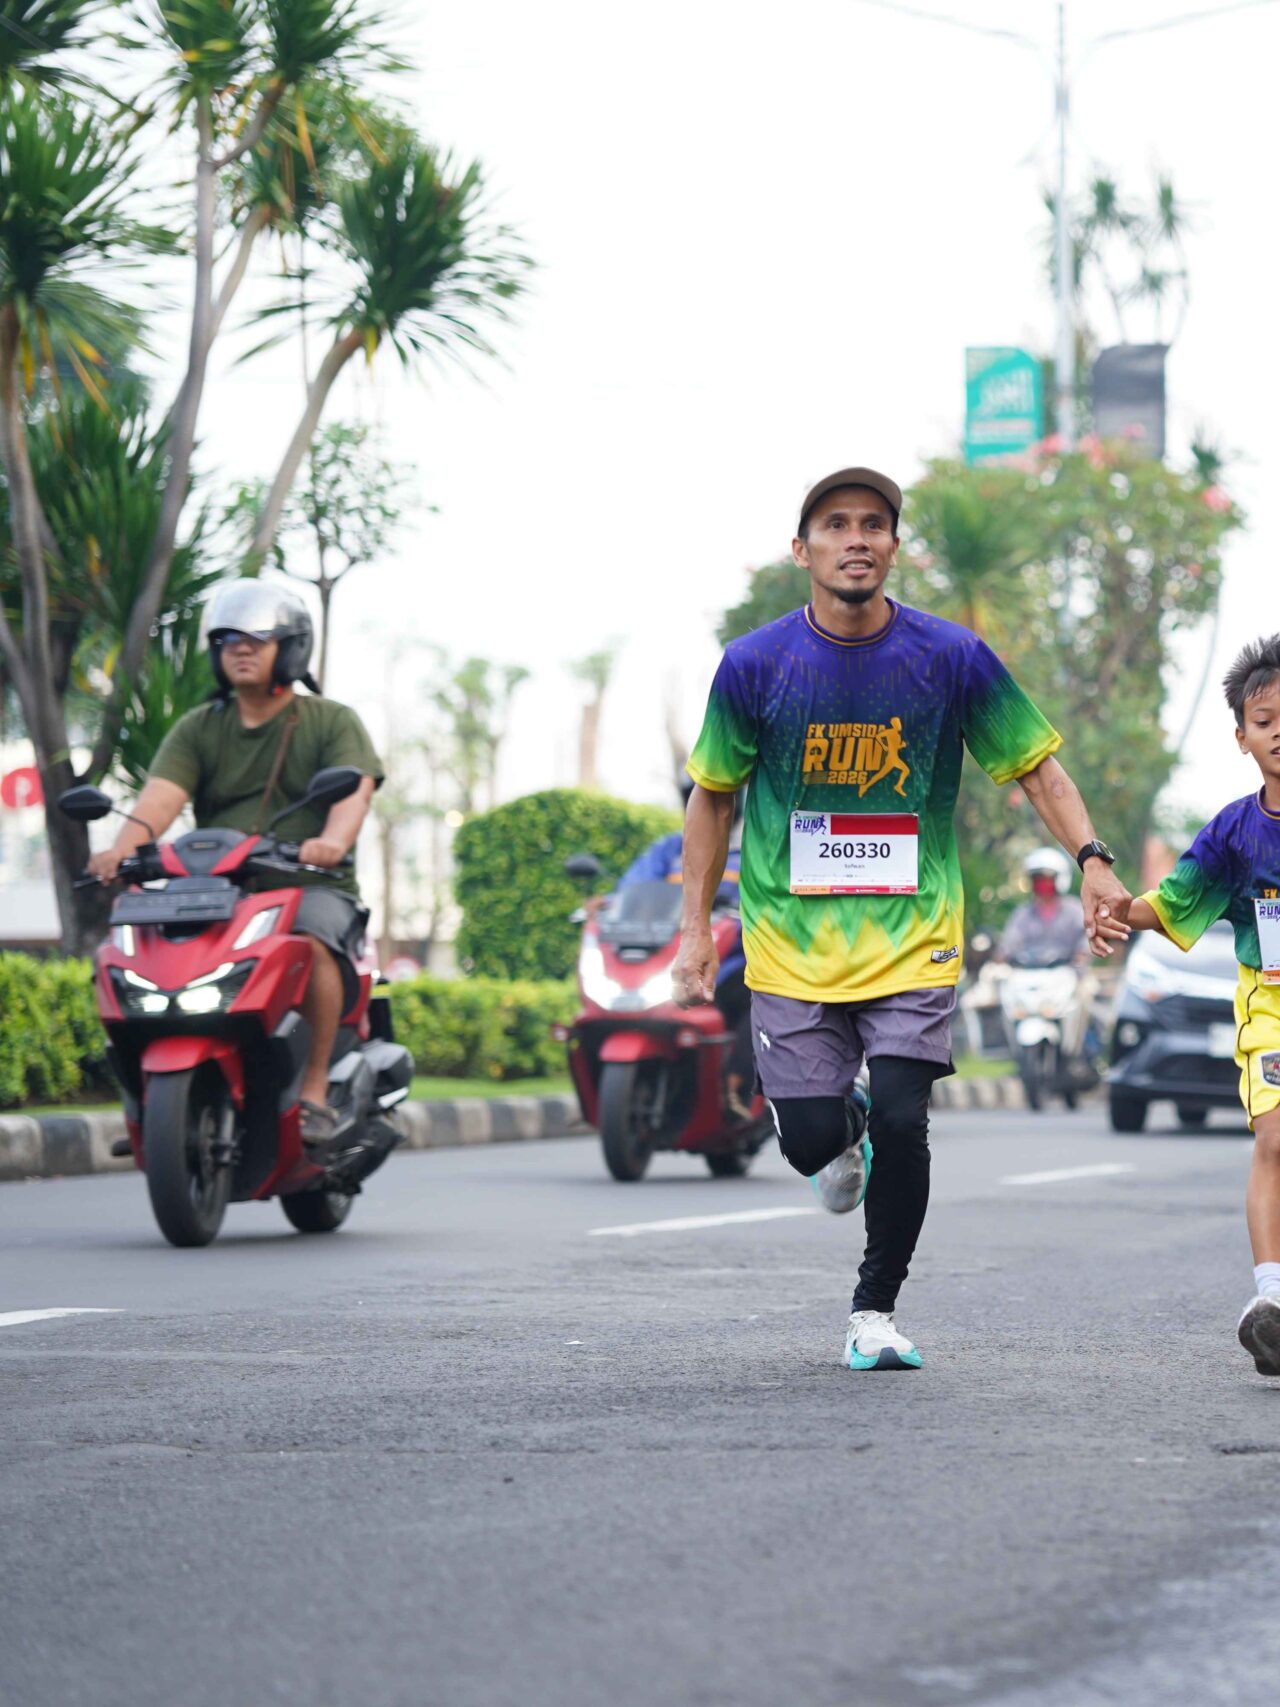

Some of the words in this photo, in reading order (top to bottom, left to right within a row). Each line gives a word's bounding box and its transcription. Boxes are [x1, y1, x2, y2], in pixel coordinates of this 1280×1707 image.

[807, 723, 826, 738] FK
[802, 737, 883, 772] RUN
[827, 771, 868, 785] 2026
[795, 819, 819, 829] RUN
[818, 842, 891, 859] 260330
[1259, 905, 1280, 916] RUN
